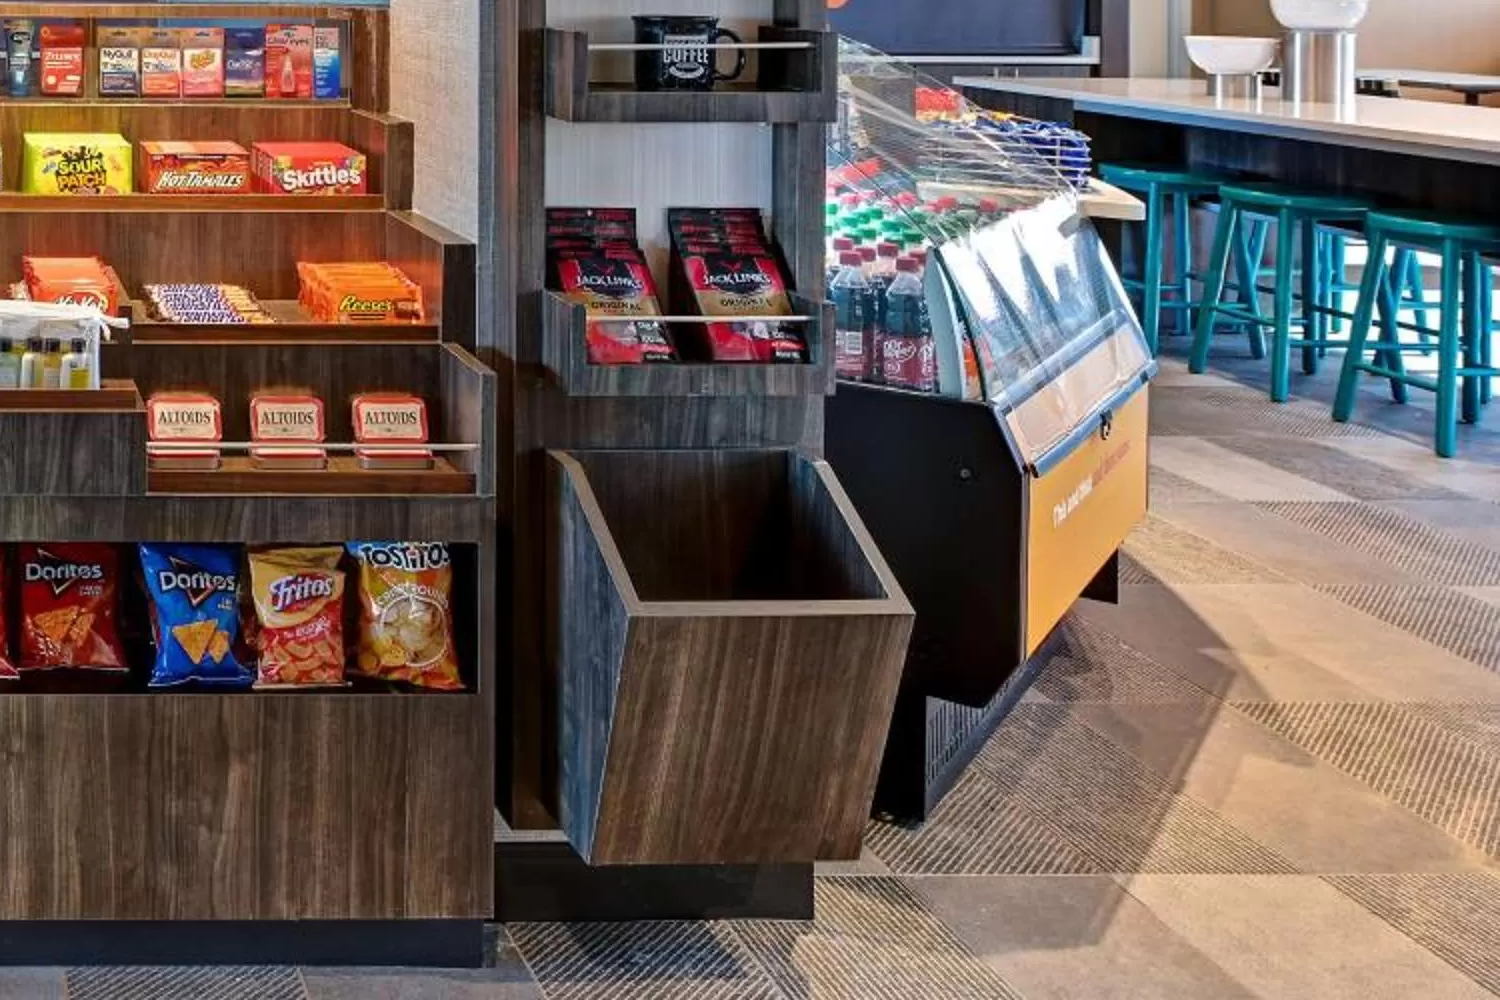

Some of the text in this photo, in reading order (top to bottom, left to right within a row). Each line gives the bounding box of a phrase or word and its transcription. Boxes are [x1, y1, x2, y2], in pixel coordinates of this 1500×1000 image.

[59, 160, 104, 175] SOUR
[57, 173, 105, 188] PATCH
[283, 164, 362, 191] Skittles
[158, 410, 211, 425] ALTOIDS
[260, 410, 315, 425] ALTOIDS
[365, 410, 418, 425] ALTOIDS
[25, 562, 103, 581] Doritos
[159, 571, 236, 592] Doritos
[269, 574, 335, 612] Fritos
